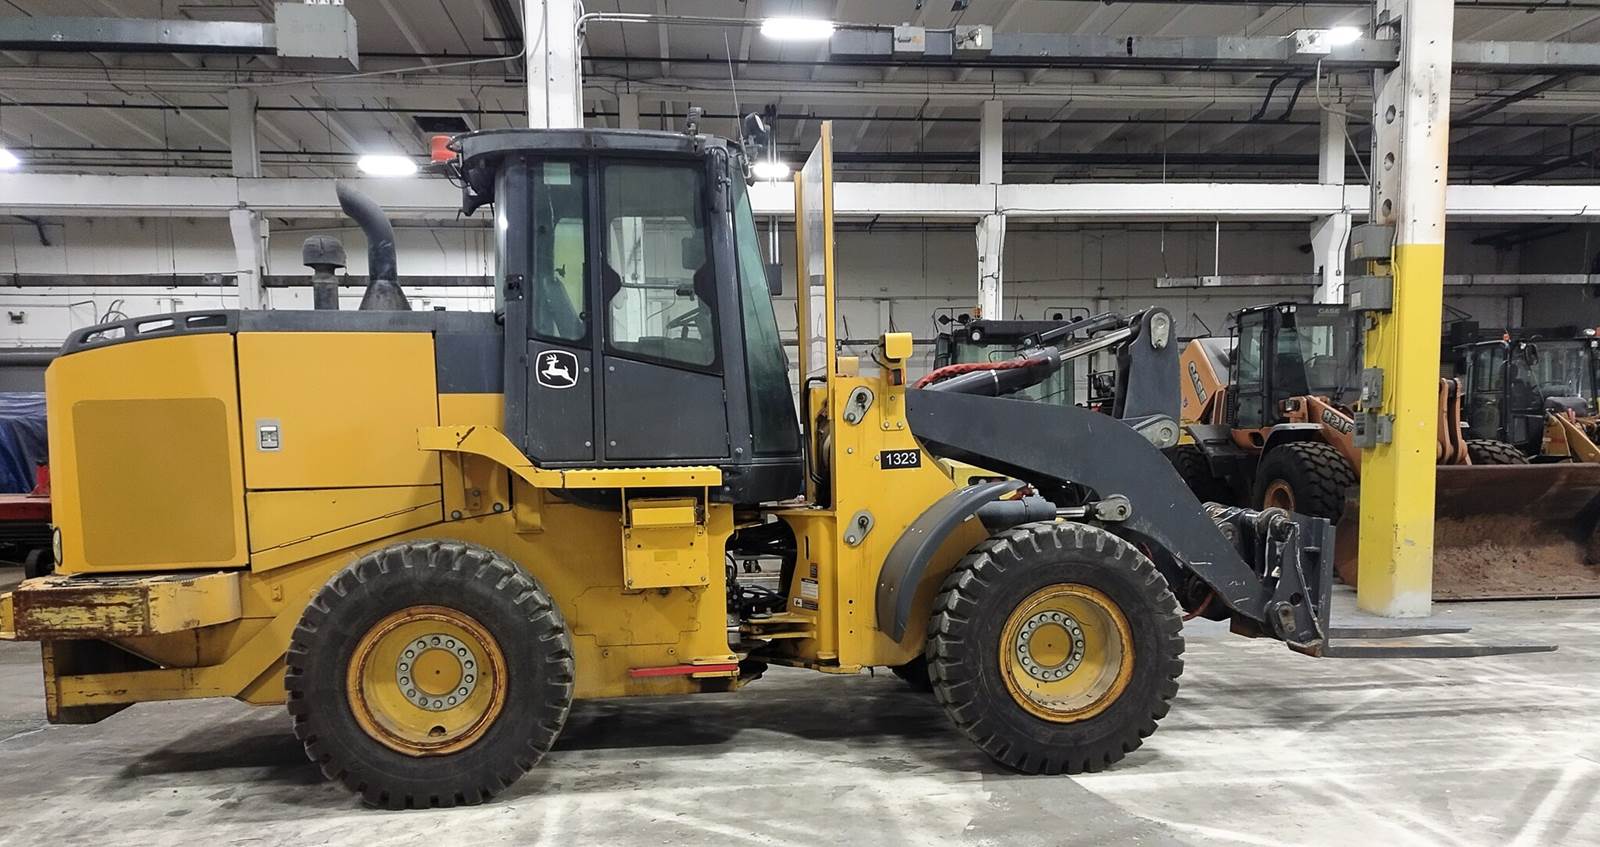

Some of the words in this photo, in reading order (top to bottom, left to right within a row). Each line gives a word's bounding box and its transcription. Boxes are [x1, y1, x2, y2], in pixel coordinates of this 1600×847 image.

[1188, 361, 1207, 405] CASE
[1322, 409, 1354, 435] 821F
[886, 452, 917, 465] 1323
